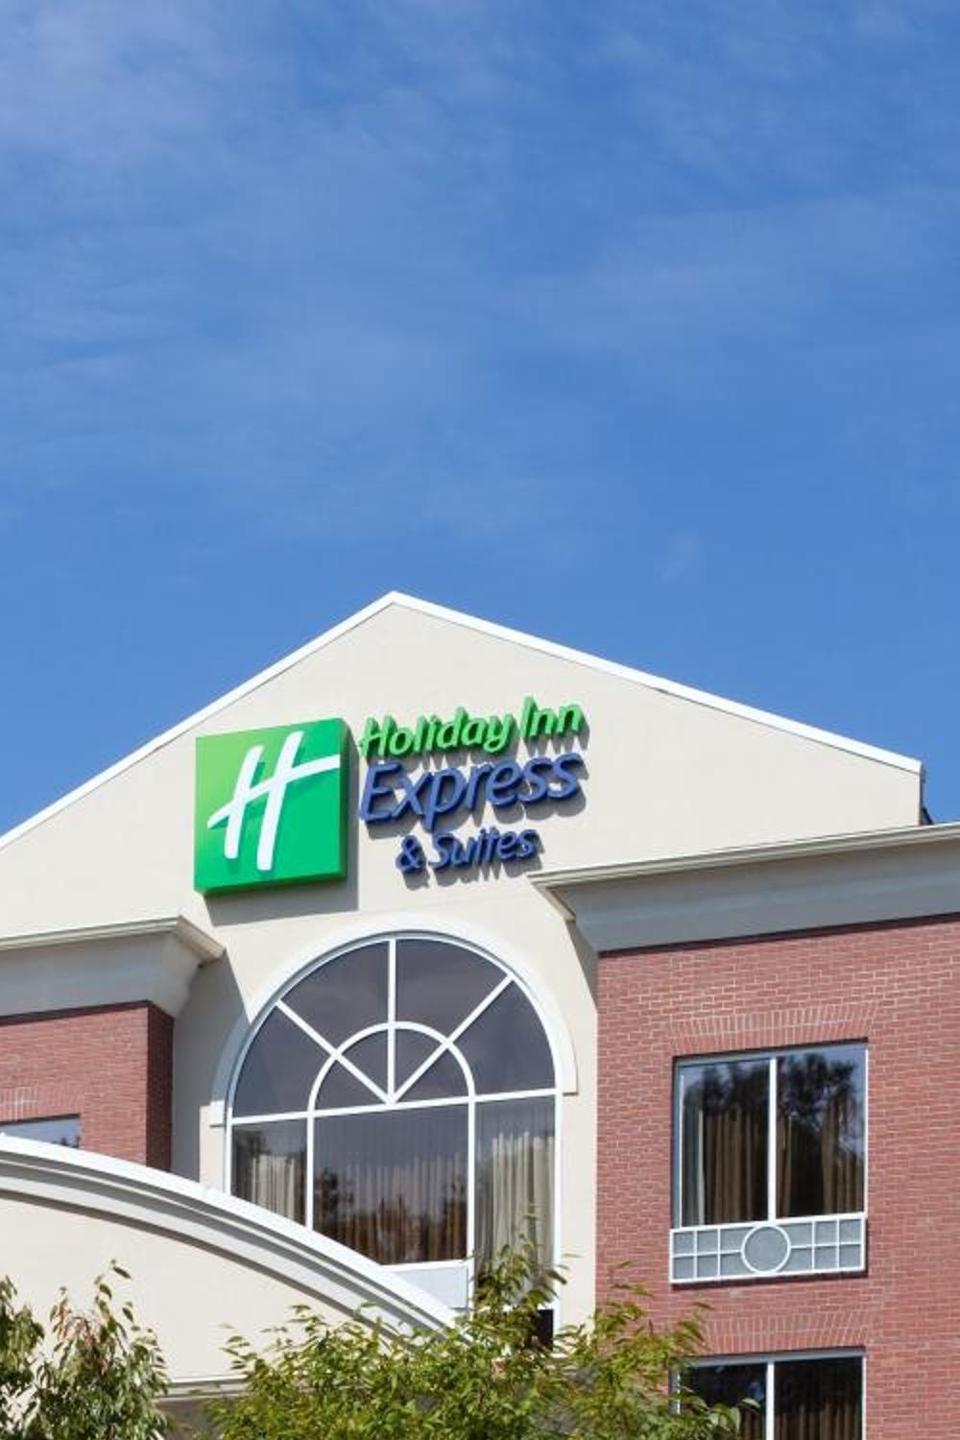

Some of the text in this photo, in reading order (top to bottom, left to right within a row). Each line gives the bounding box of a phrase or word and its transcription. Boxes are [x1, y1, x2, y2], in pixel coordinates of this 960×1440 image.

[359, 696, 584, 757] Holiday Inn
[207, 731, 340, 871] H
[359, 752, 583, 832] Express
[395, 826, 540, 873] & Suites
